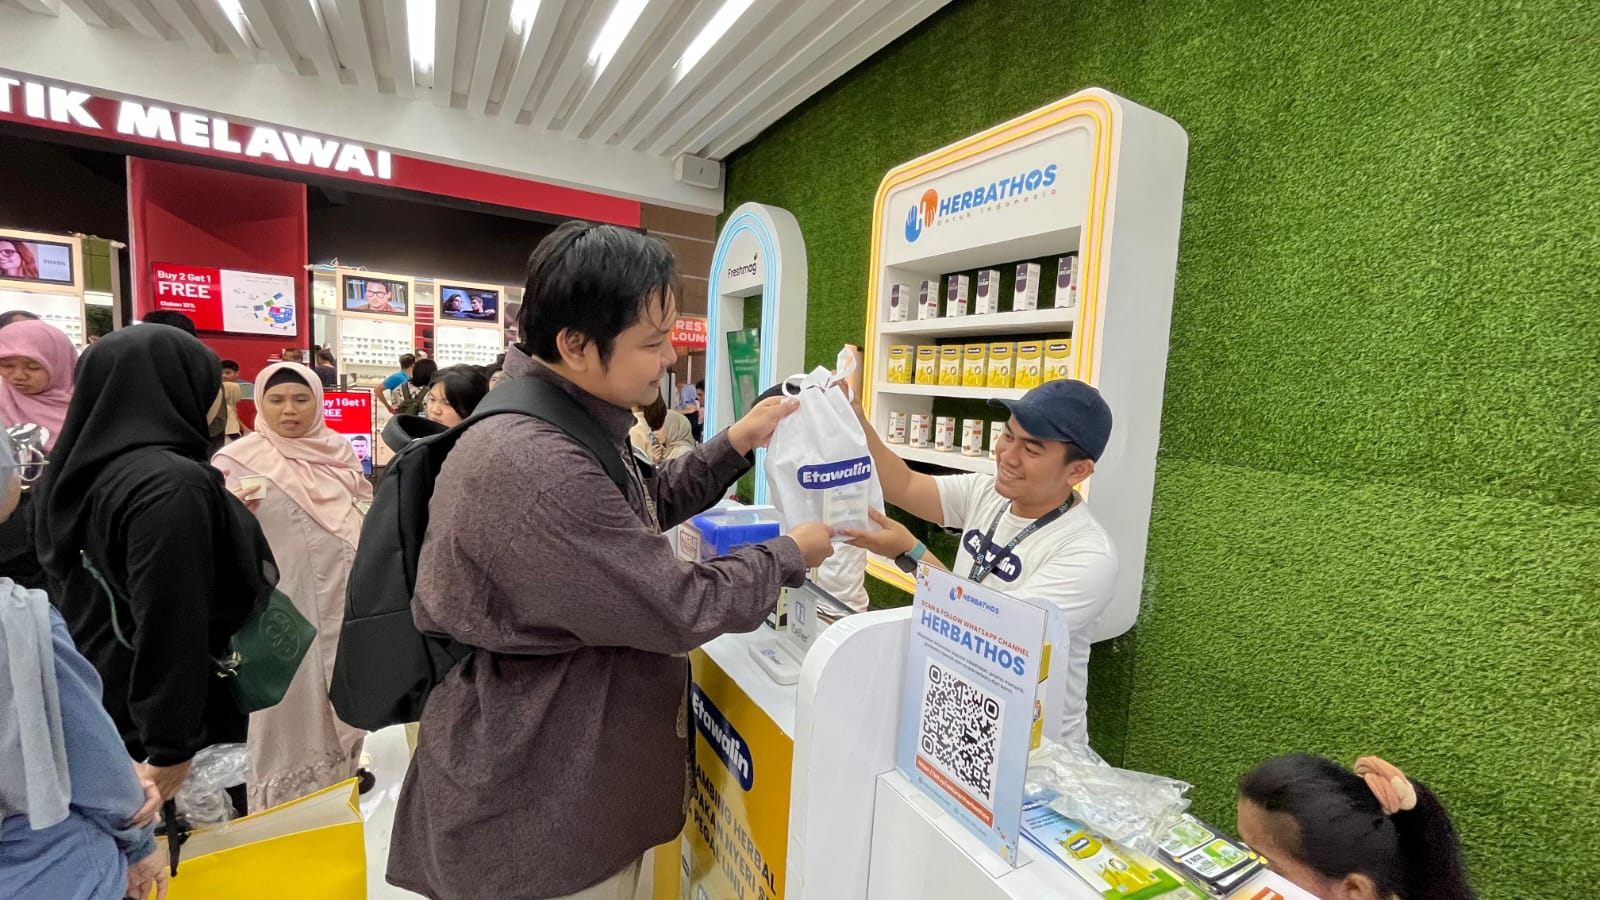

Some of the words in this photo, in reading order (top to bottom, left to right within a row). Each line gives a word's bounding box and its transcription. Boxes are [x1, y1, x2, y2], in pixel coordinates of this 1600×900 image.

[117, 100, 392, 180] MELAWAI
[939, 164, 1058, 217] HERBATHOS
[157, 270, 177, 281] Buy
[179, 272, 186, 281] 2
[187, 273, 205, 282] Get
[206, 275, 212, 283] 1
[158, 281, 211, 299] FREE
[322, 399, 334, 408] uy
[335, 398, 341, 406] 1
[342, 397, 360, 407] Get
[361, 398, 367, 407] 1
[323, 408, 343, 417] REE
[802, 462, 871, 484] Etawalin
[921, 599, 936, 612] SCAN
[935, 606, 940, 614] &
[940, 608, 963, 625] FOLLOW
[963, 619, 998, 641] WHATSAPP
[997, 637, 1030, 658] CHANNEL
[963, 593, 1000, 615] HERBATHOS
[921, 609, 1026, 676] HERBATHOS
[692, 691, 749, 780] Etawalin
[694, 808, 720, 865] PEGAL
[722, 854, 745, 900] LINU
[696, 763, 732, 827] AMBING
[733, 817, 776, 896] HERBAL
[726, 832, 756, 893] NYERI
